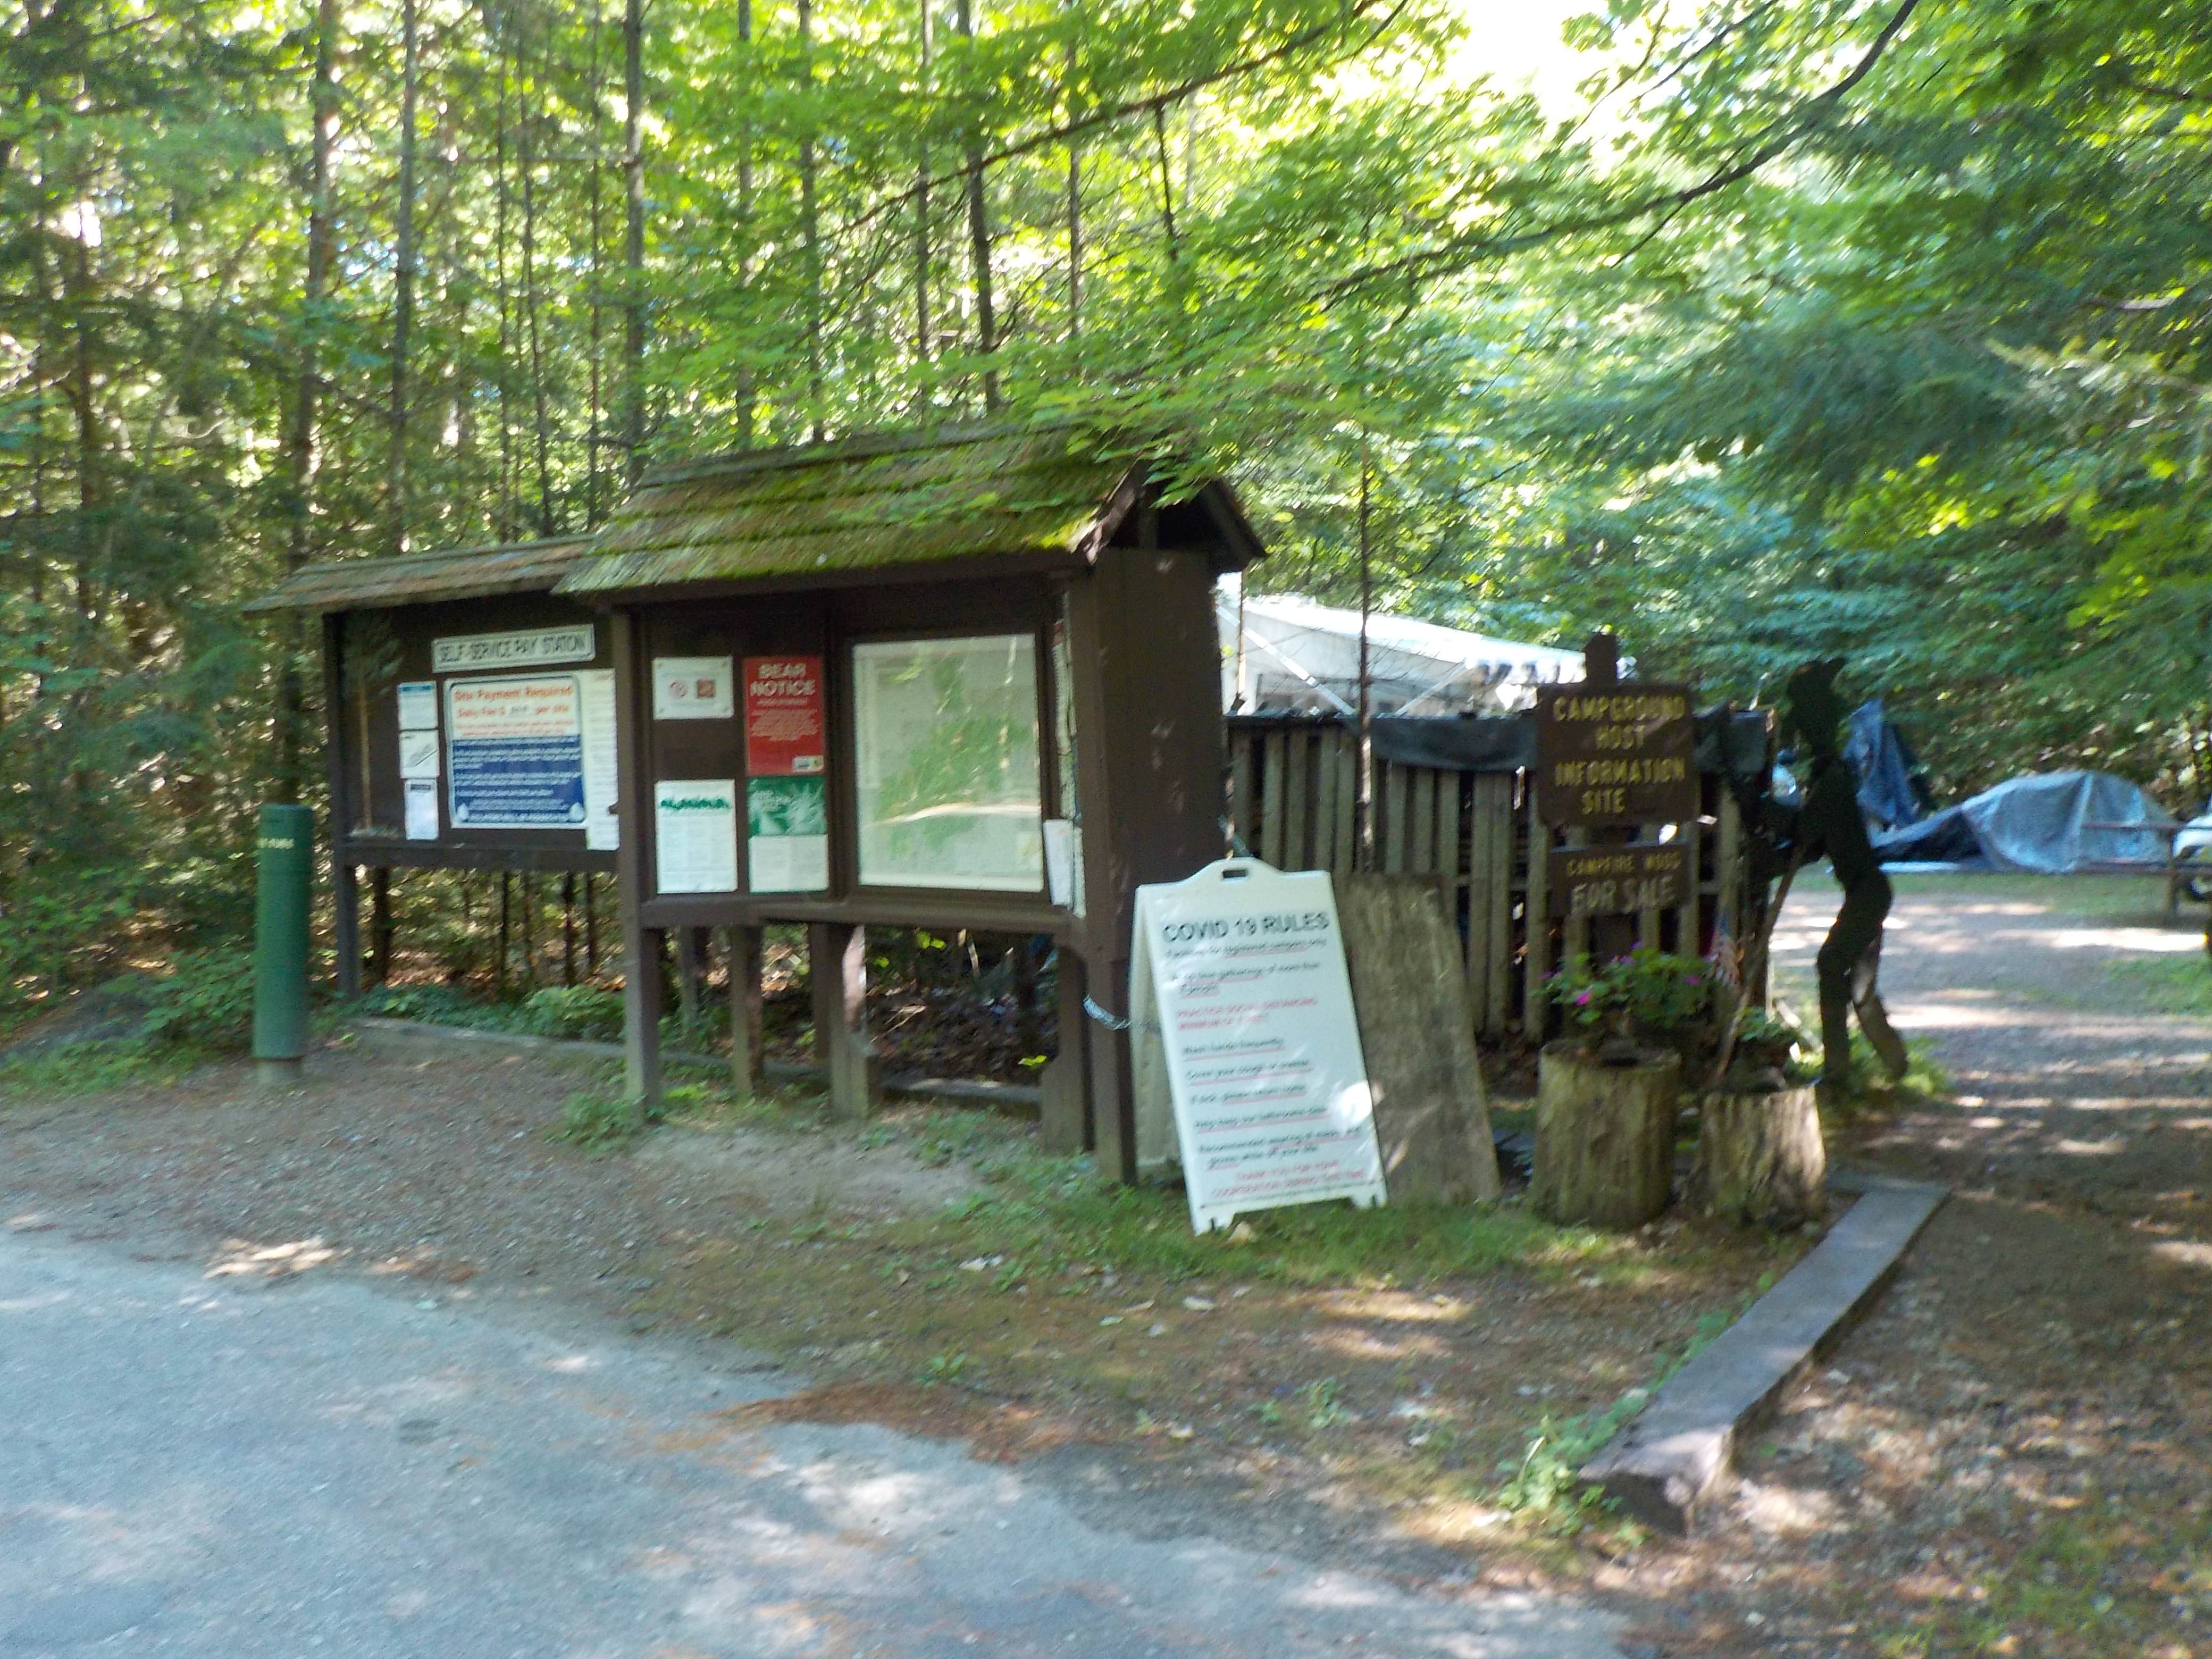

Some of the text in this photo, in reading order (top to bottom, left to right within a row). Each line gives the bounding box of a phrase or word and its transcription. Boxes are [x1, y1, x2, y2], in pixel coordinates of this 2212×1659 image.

[515, 638, 538, 653] PAY
[543, 634, 588, 655] STATION
[758, 663, 807, 679] BEAR
[477, 689, 520, 702] Payment
[524, 685, 573, 699] Required
[750, 680, 816, 697] NOTICE
[1553, 695, 1685, 722] CAMPGROUND
[1596, 724, 1646, 749] HOST
[1555, 758, 1685, 787] INFORMATION
[1581, 787, 1626, 815] SITE
[1571, 875, 1675, 914] FOR SALE
[1162, 911, 1329, 942] COVID 19 RULES
